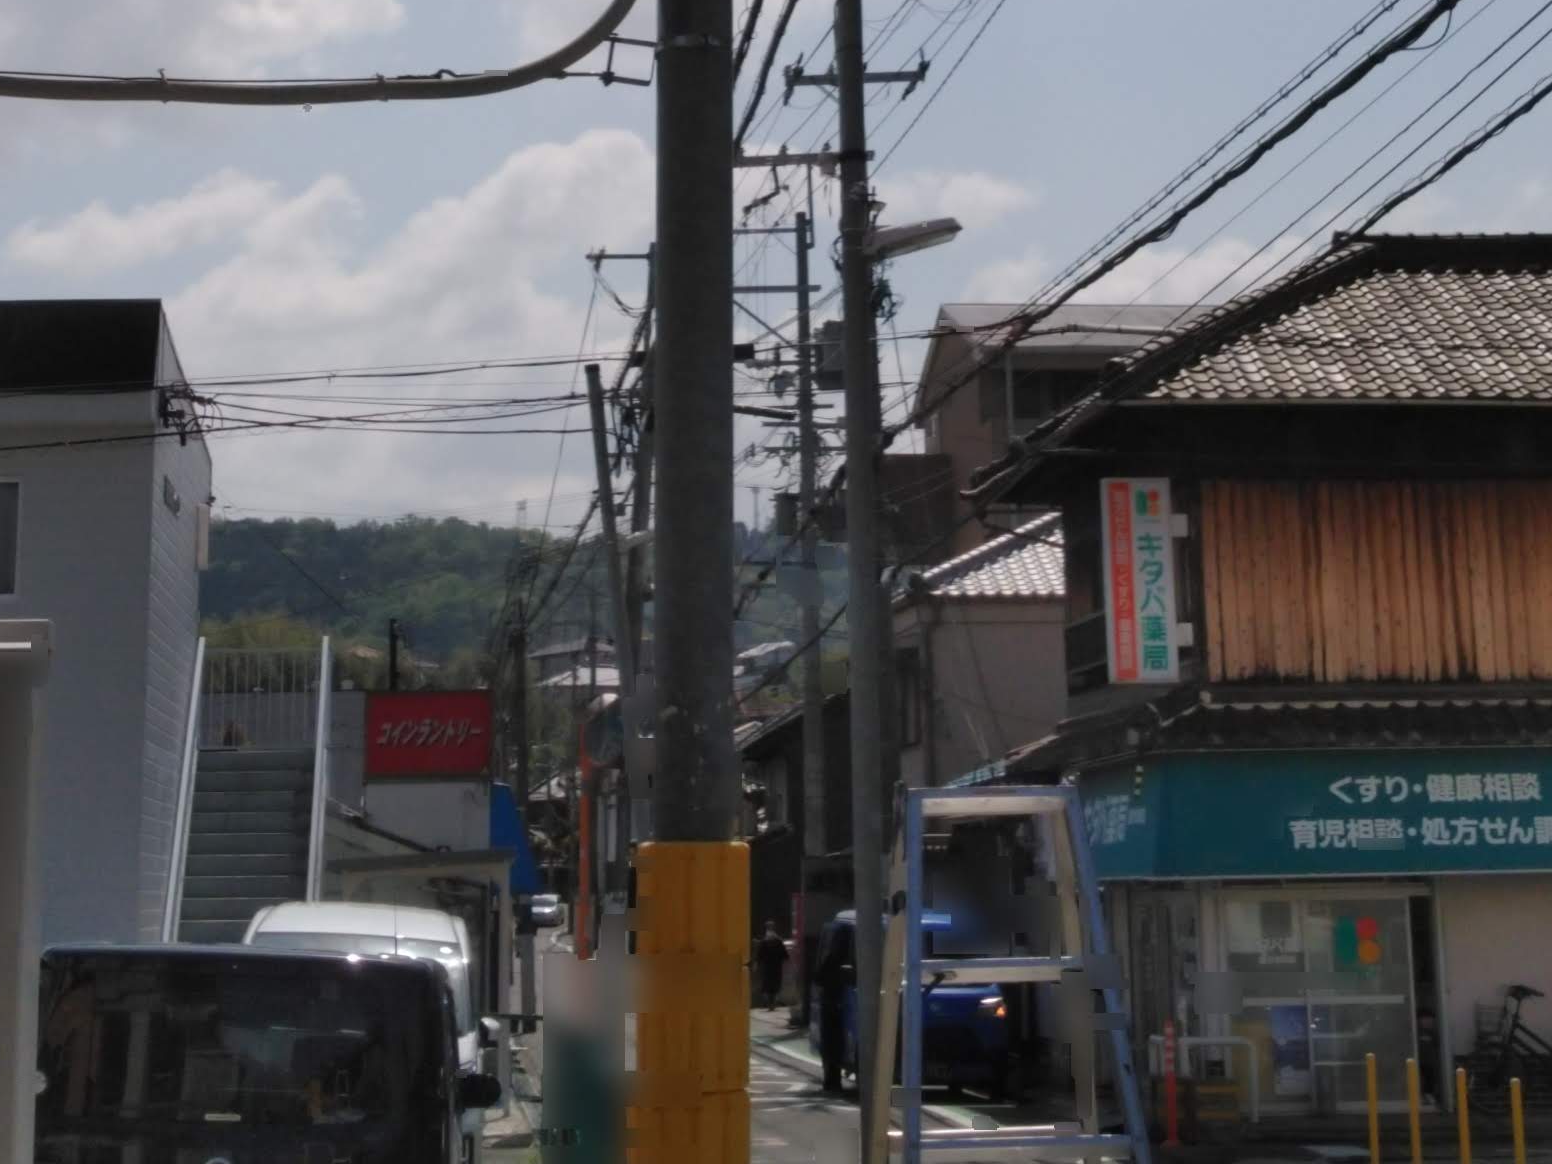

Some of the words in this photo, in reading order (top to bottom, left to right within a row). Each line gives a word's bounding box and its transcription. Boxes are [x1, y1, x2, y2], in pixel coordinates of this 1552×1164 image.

[1329, 773, 1543, 805] くすり・健康相談
